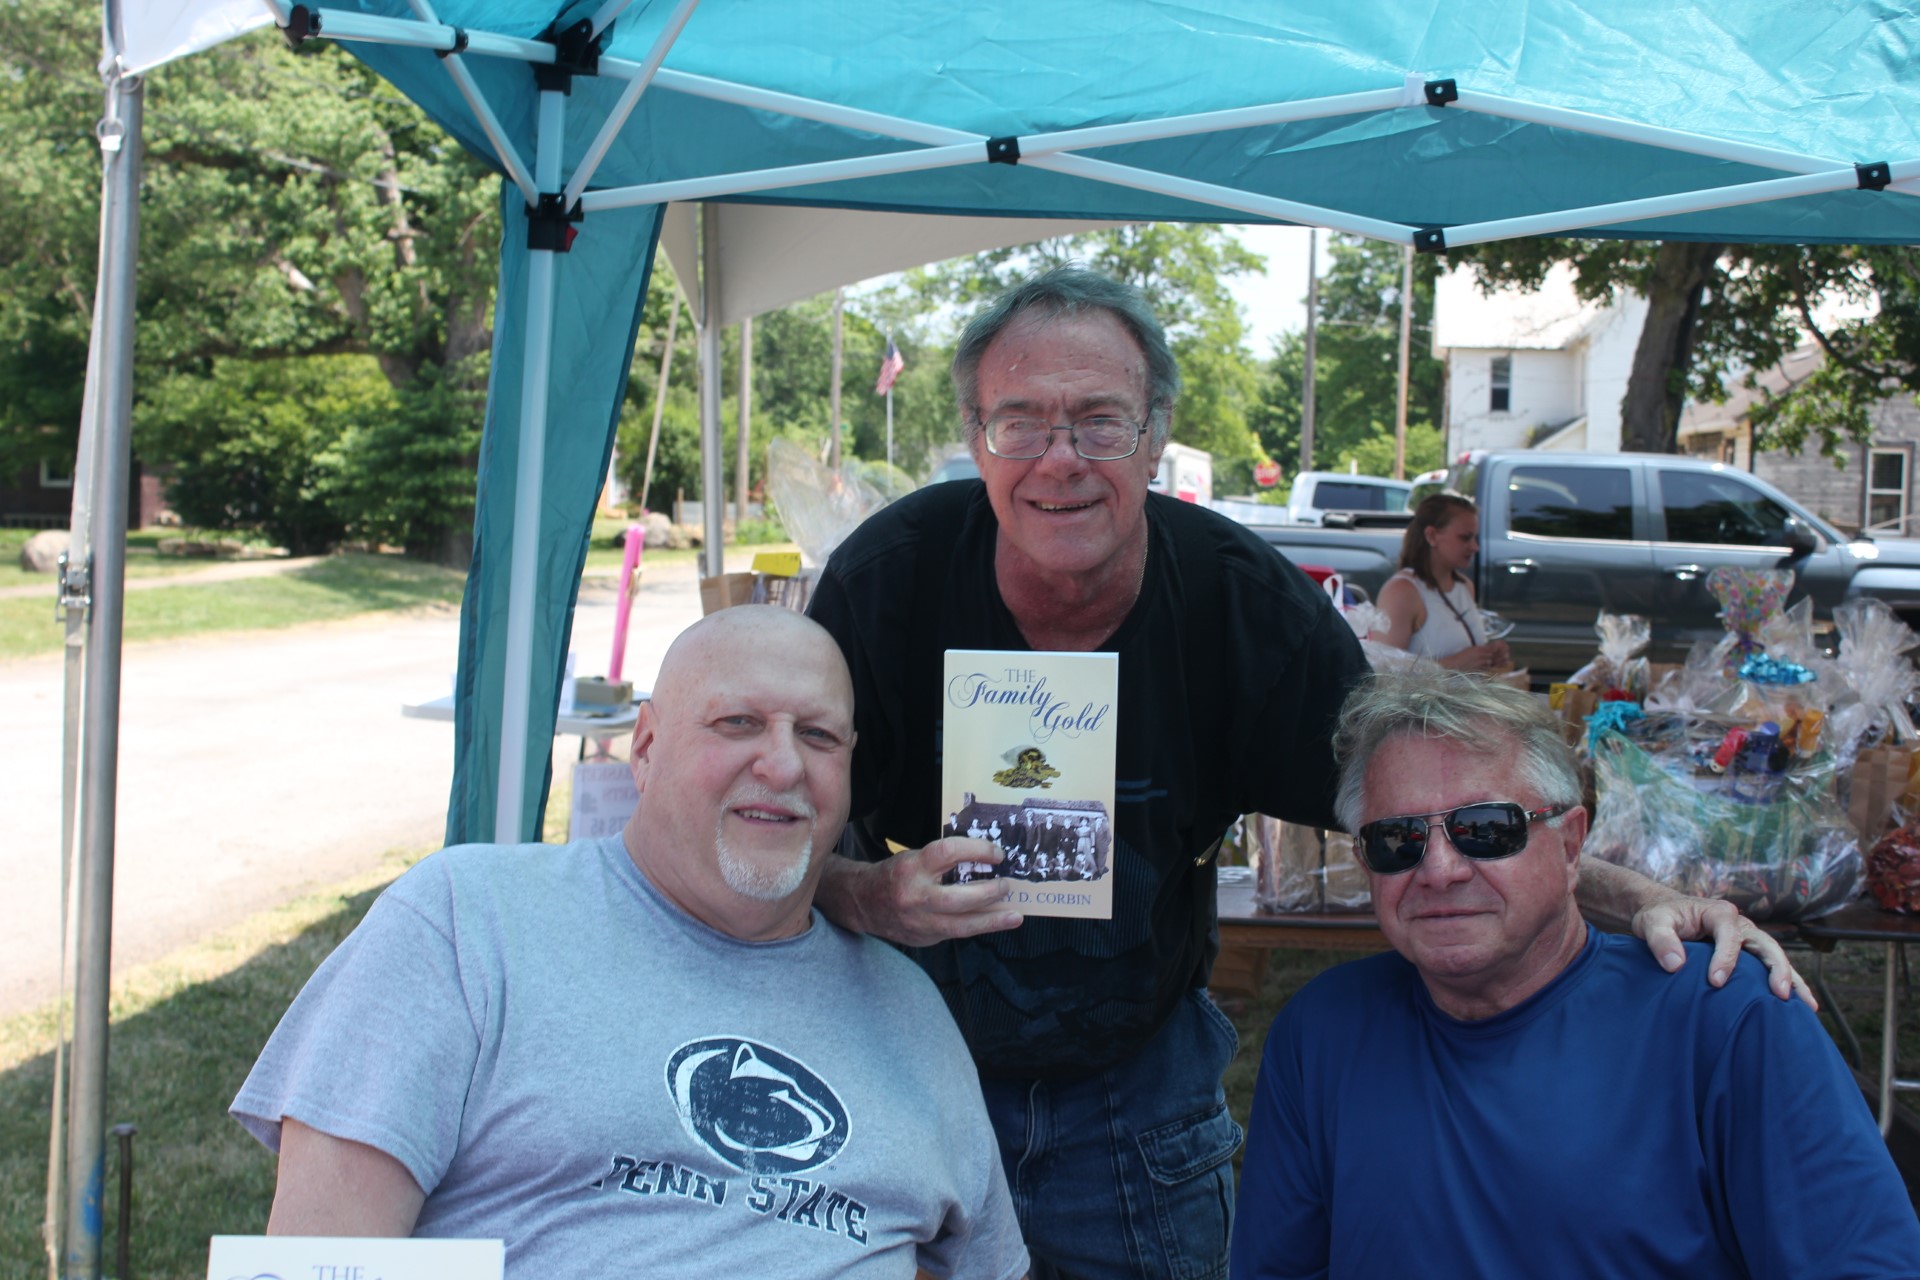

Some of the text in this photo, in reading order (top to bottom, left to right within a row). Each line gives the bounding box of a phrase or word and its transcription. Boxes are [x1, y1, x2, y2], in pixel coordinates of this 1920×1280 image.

[948, 673, 1055, 717] Family
[1004, 669, 1036, 683] THE
[1029, 702, 1110, 744] Gold
[1019, 892, 1031, 904] D.
[1036, 893, 1092, 906] CORBIN
[589, 1152, 869, 1247] PENN STATE
